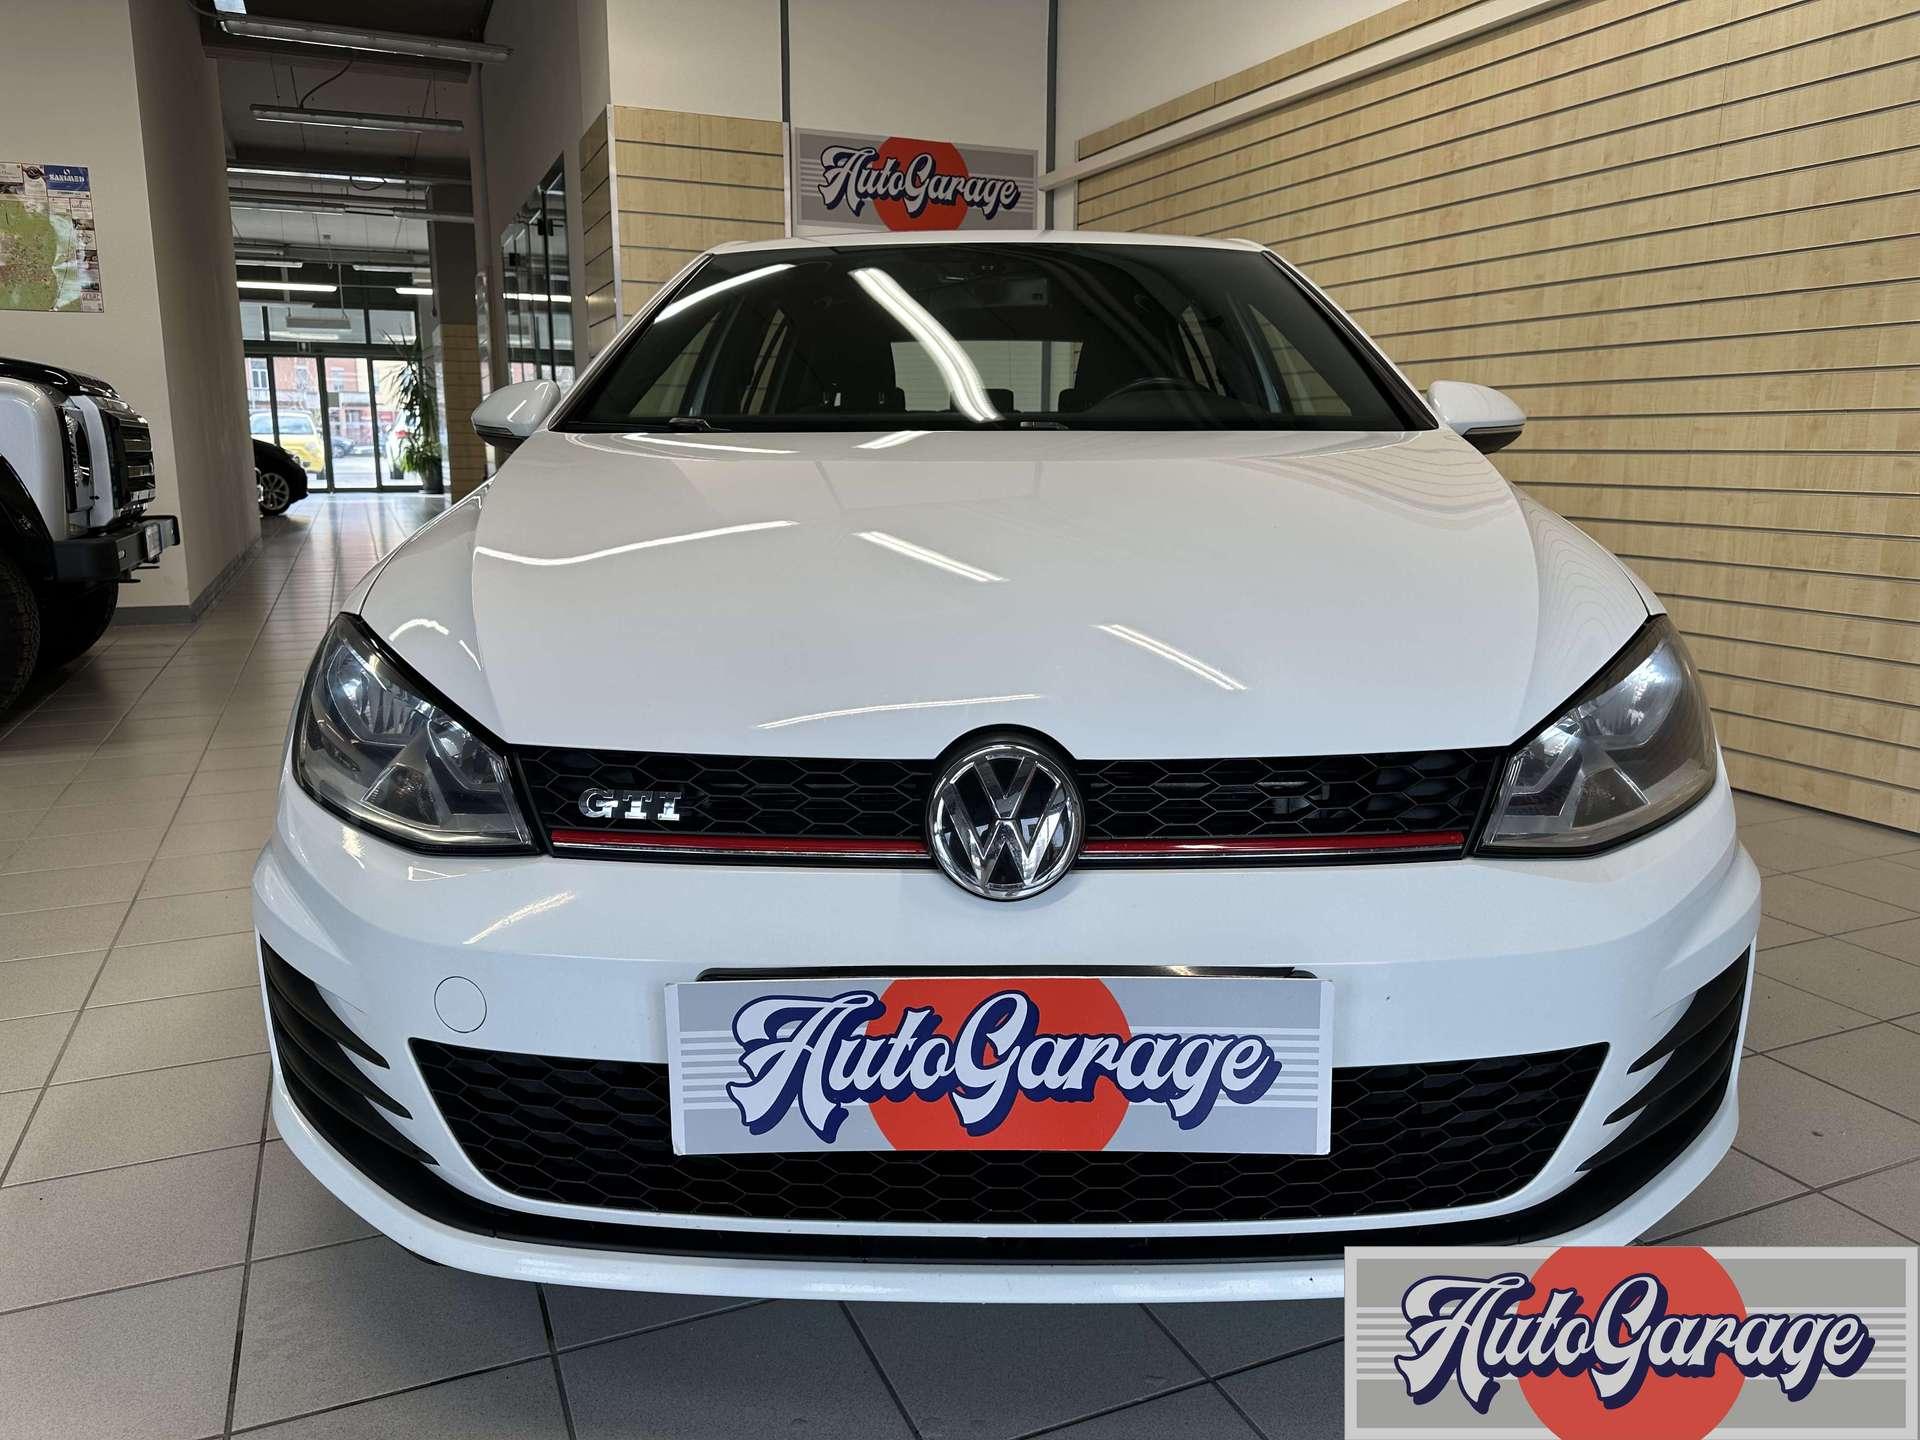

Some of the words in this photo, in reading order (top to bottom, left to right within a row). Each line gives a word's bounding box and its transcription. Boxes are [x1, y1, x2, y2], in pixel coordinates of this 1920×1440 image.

[818, 145, 1021, 220] AutoGarage
[578, 787, 682, 821] GTI
[727, 989, 1282, 1144] AutoGarage
